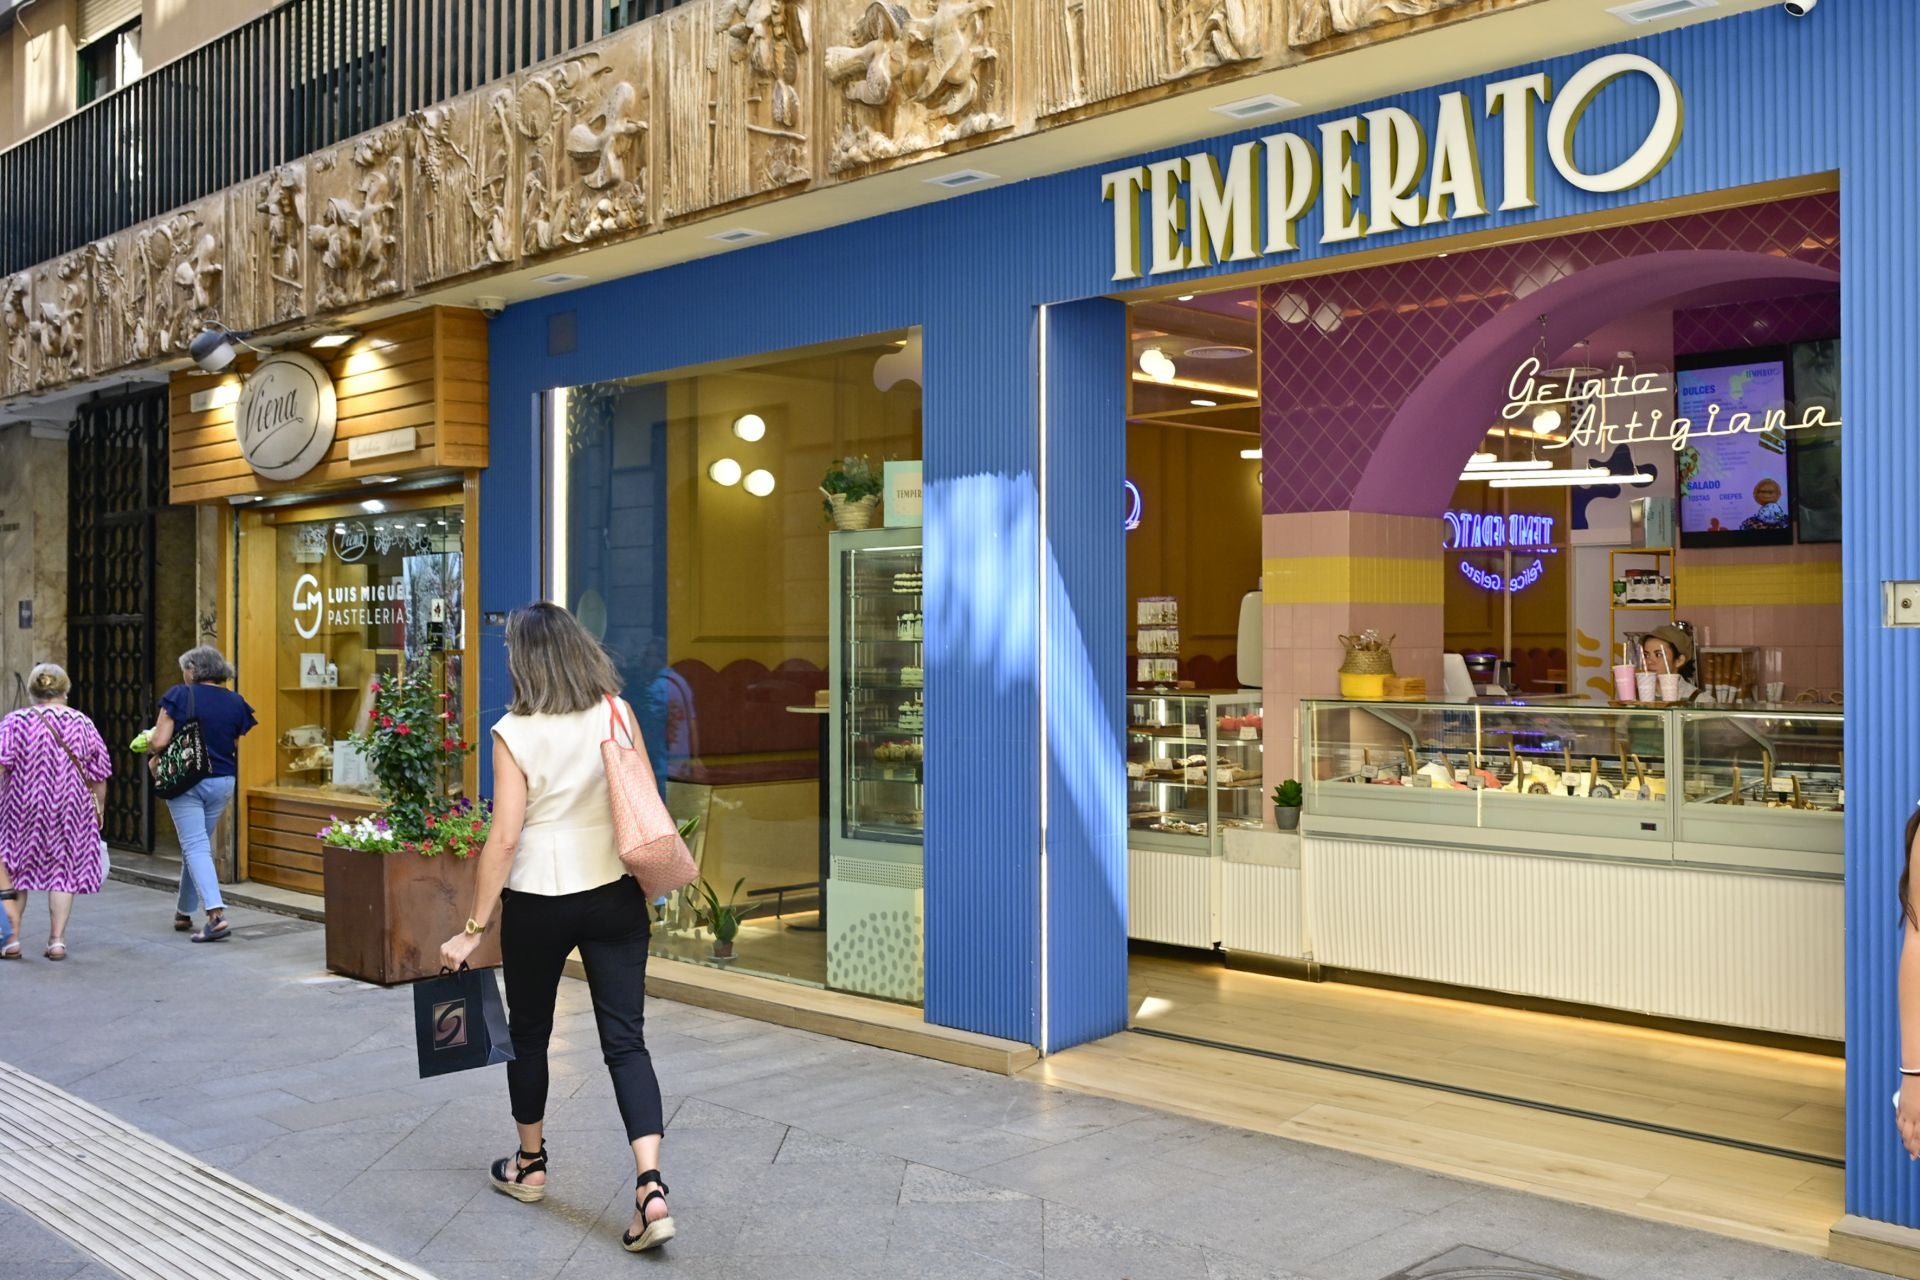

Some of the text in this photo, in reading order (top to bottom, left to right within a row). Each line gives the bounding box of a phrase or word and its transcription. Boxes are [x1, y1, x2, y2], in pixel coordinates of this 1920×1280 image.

[1101, 53, 1684, 281] TEMPERATO
[1502, 357, 1667, 418] Gelato
[1683, 385, 1715, 396] DULCES
[241, 374, 300, 443] Viena
[1542, 404, 1843, 450] Artigiana
[1687, 480, 1720, 490] SALADO
[328, 584, 412, 603] LUIS MIGUEL
[328, 608, 413, 625] PASTELERIAS
